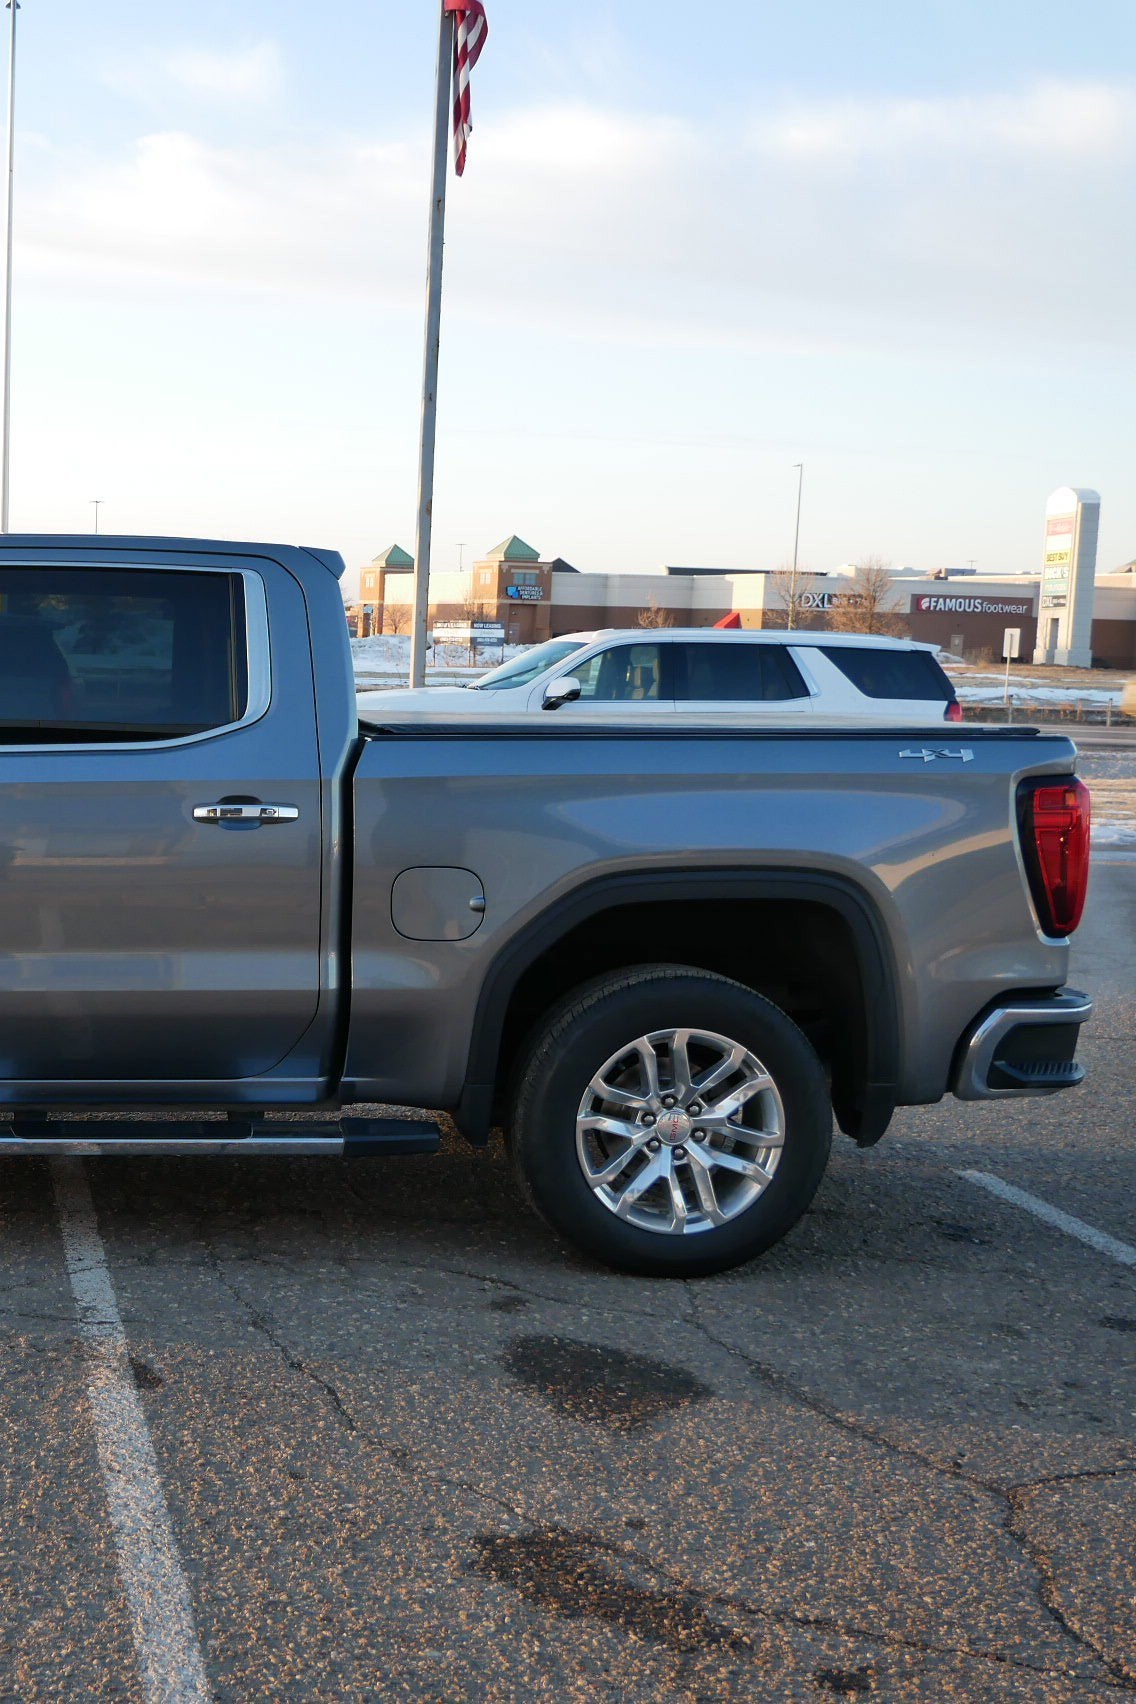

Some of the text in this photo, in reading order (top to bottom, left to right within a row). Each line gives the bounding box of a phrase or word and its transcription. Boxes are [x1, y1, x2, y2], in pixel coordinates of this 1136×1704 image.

[801, 593, 833, 608] DXL
[930, 597, 1028, 614] FAMOUS footwear
[670, 1117, 679, 1141] GMC
